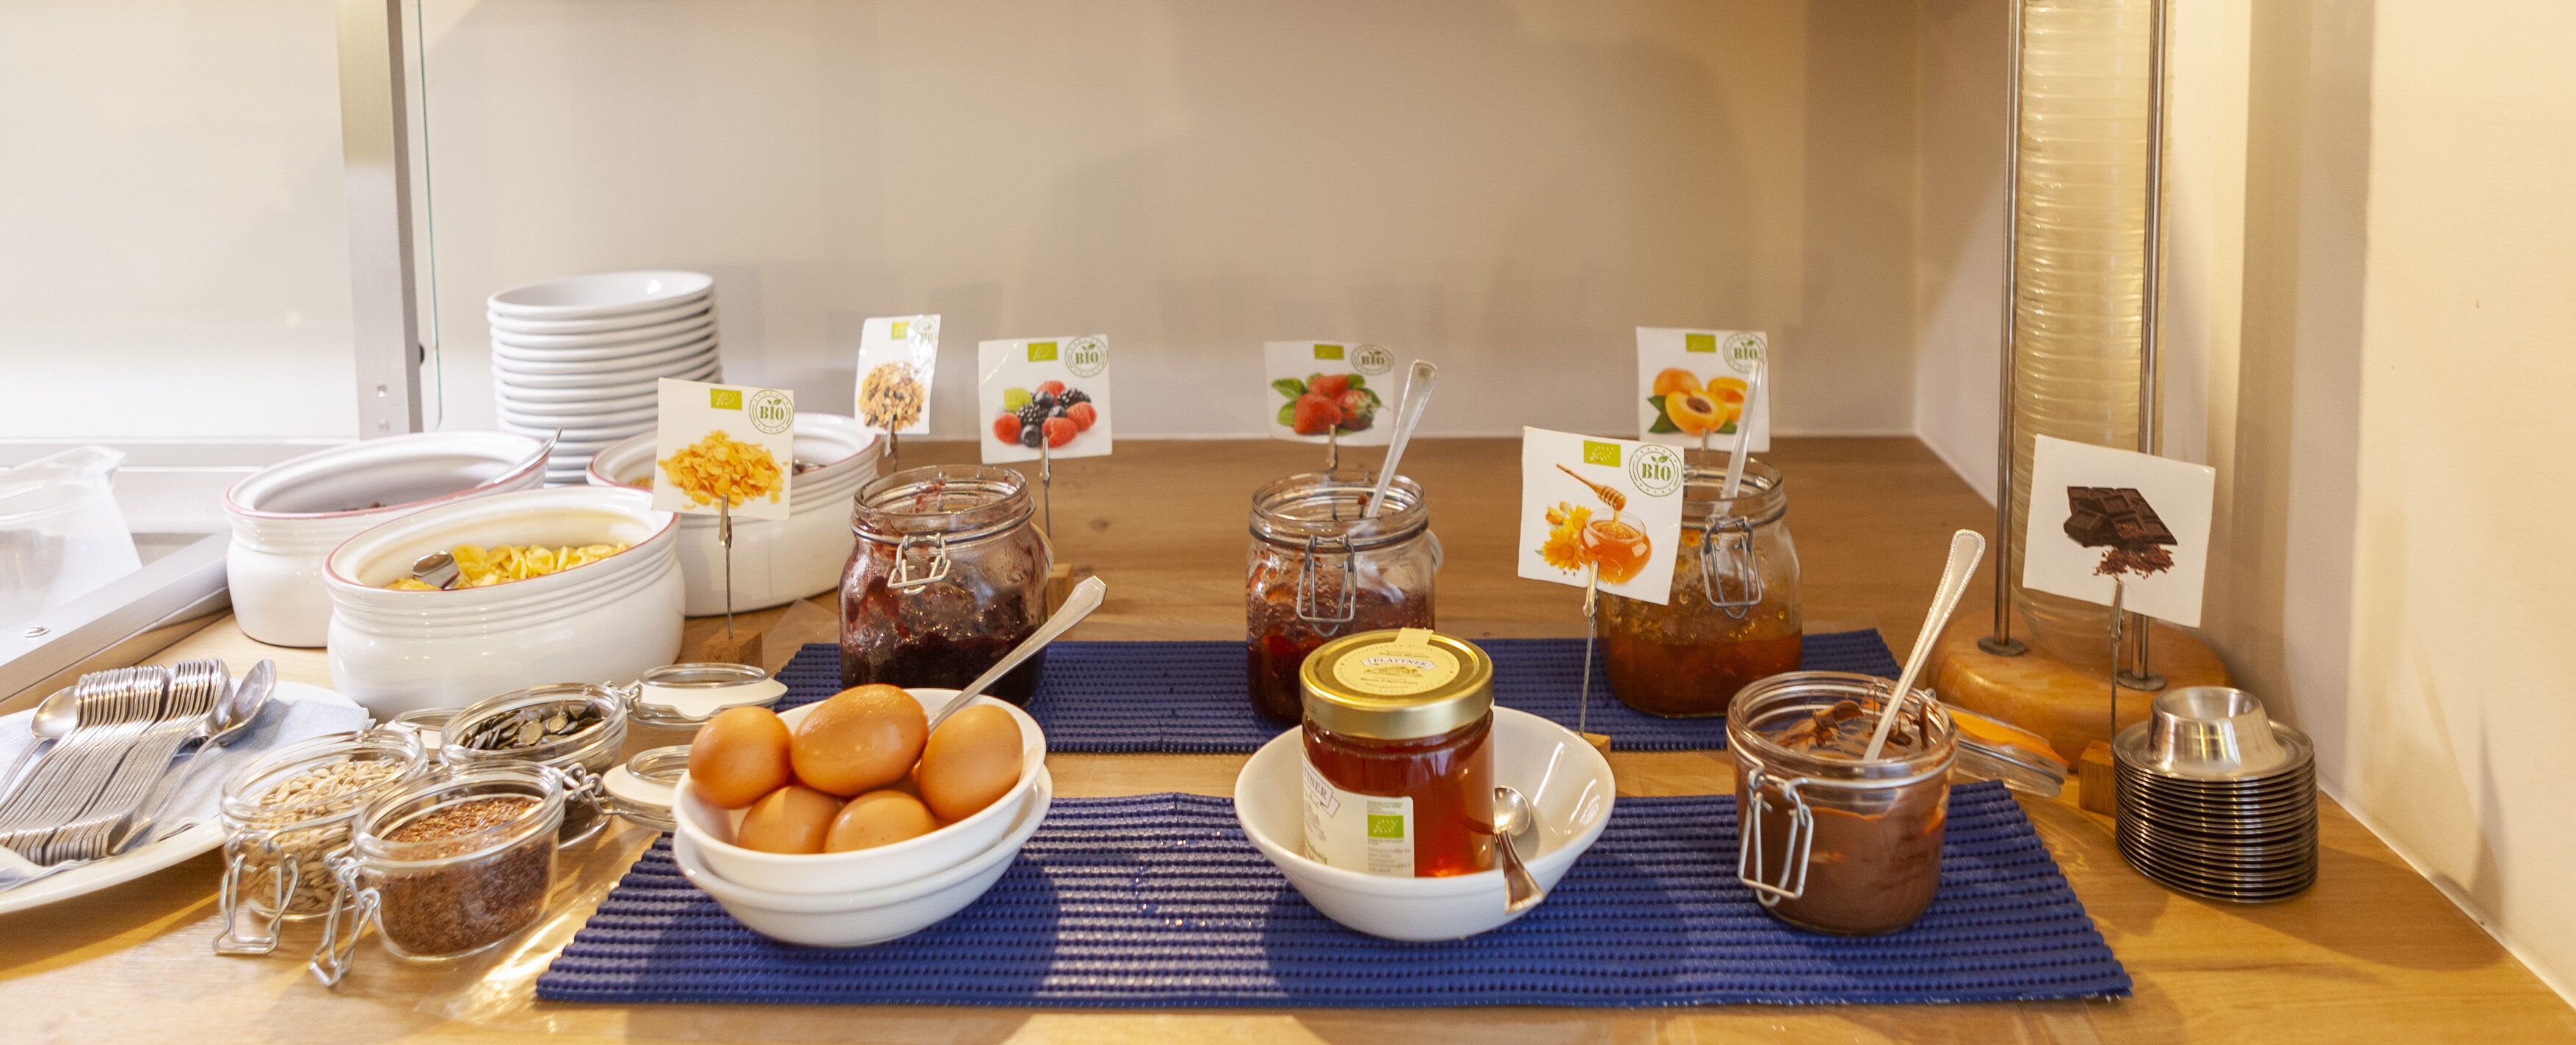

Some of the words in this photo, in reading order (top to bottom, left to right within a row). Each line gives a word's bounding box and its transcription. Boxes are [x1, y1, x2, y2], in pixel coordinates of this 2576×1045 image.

[1075, 352, 1099, 365] BIO
[1362, 355, 1385, 365] BIO
[1734, 347, 1757, 360] BIO
[760, 406, 785, 420] BIO
[1641, 463, 1671, 481] BIO
[1374, 657, 1427, 667] PLATTNER
